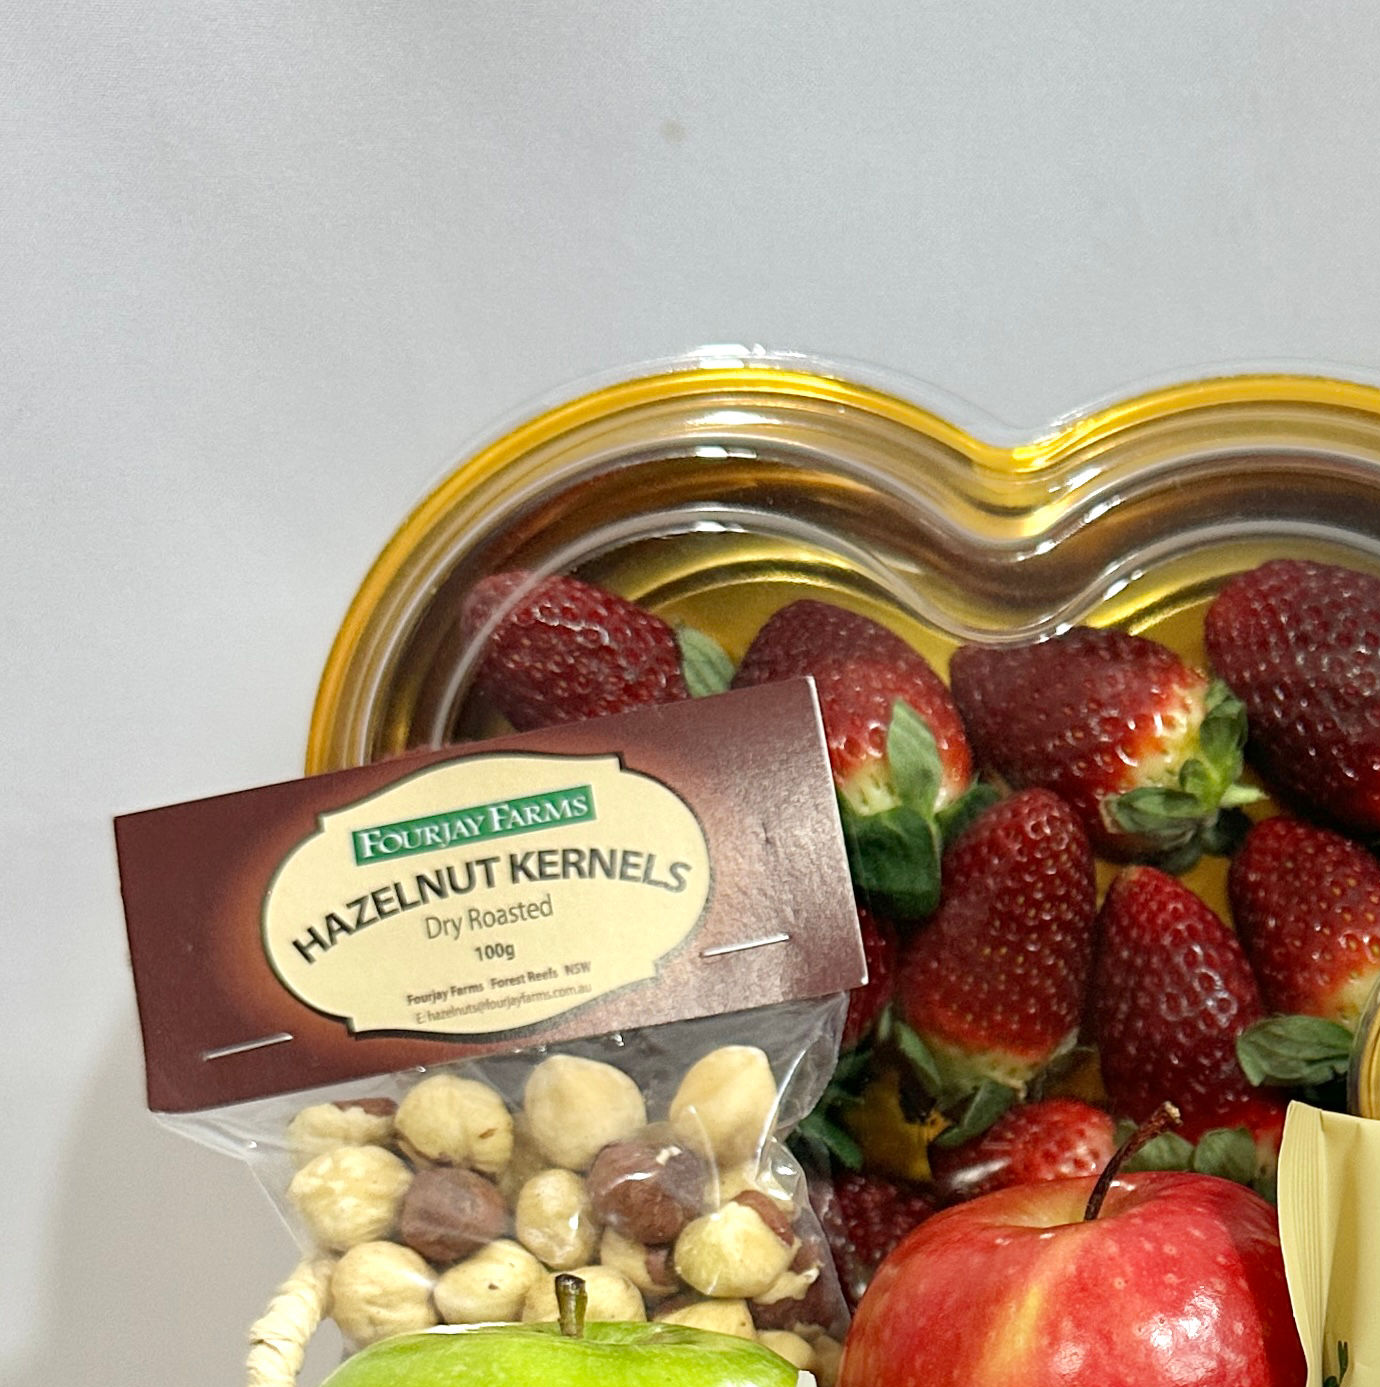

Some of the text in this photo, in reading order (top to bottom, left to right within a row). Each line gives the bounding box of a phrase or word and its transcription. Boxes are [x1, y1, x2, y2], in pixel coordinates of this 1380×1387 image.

[291, 847, 692, 964] HAZELNUT KERNELS
[425, 893, 555, 942] Dry Roasted
[474, 941, 516, 964] 100g
[406, 961, 592, 1007] Fourjay Farms Forest Reefs NSW
